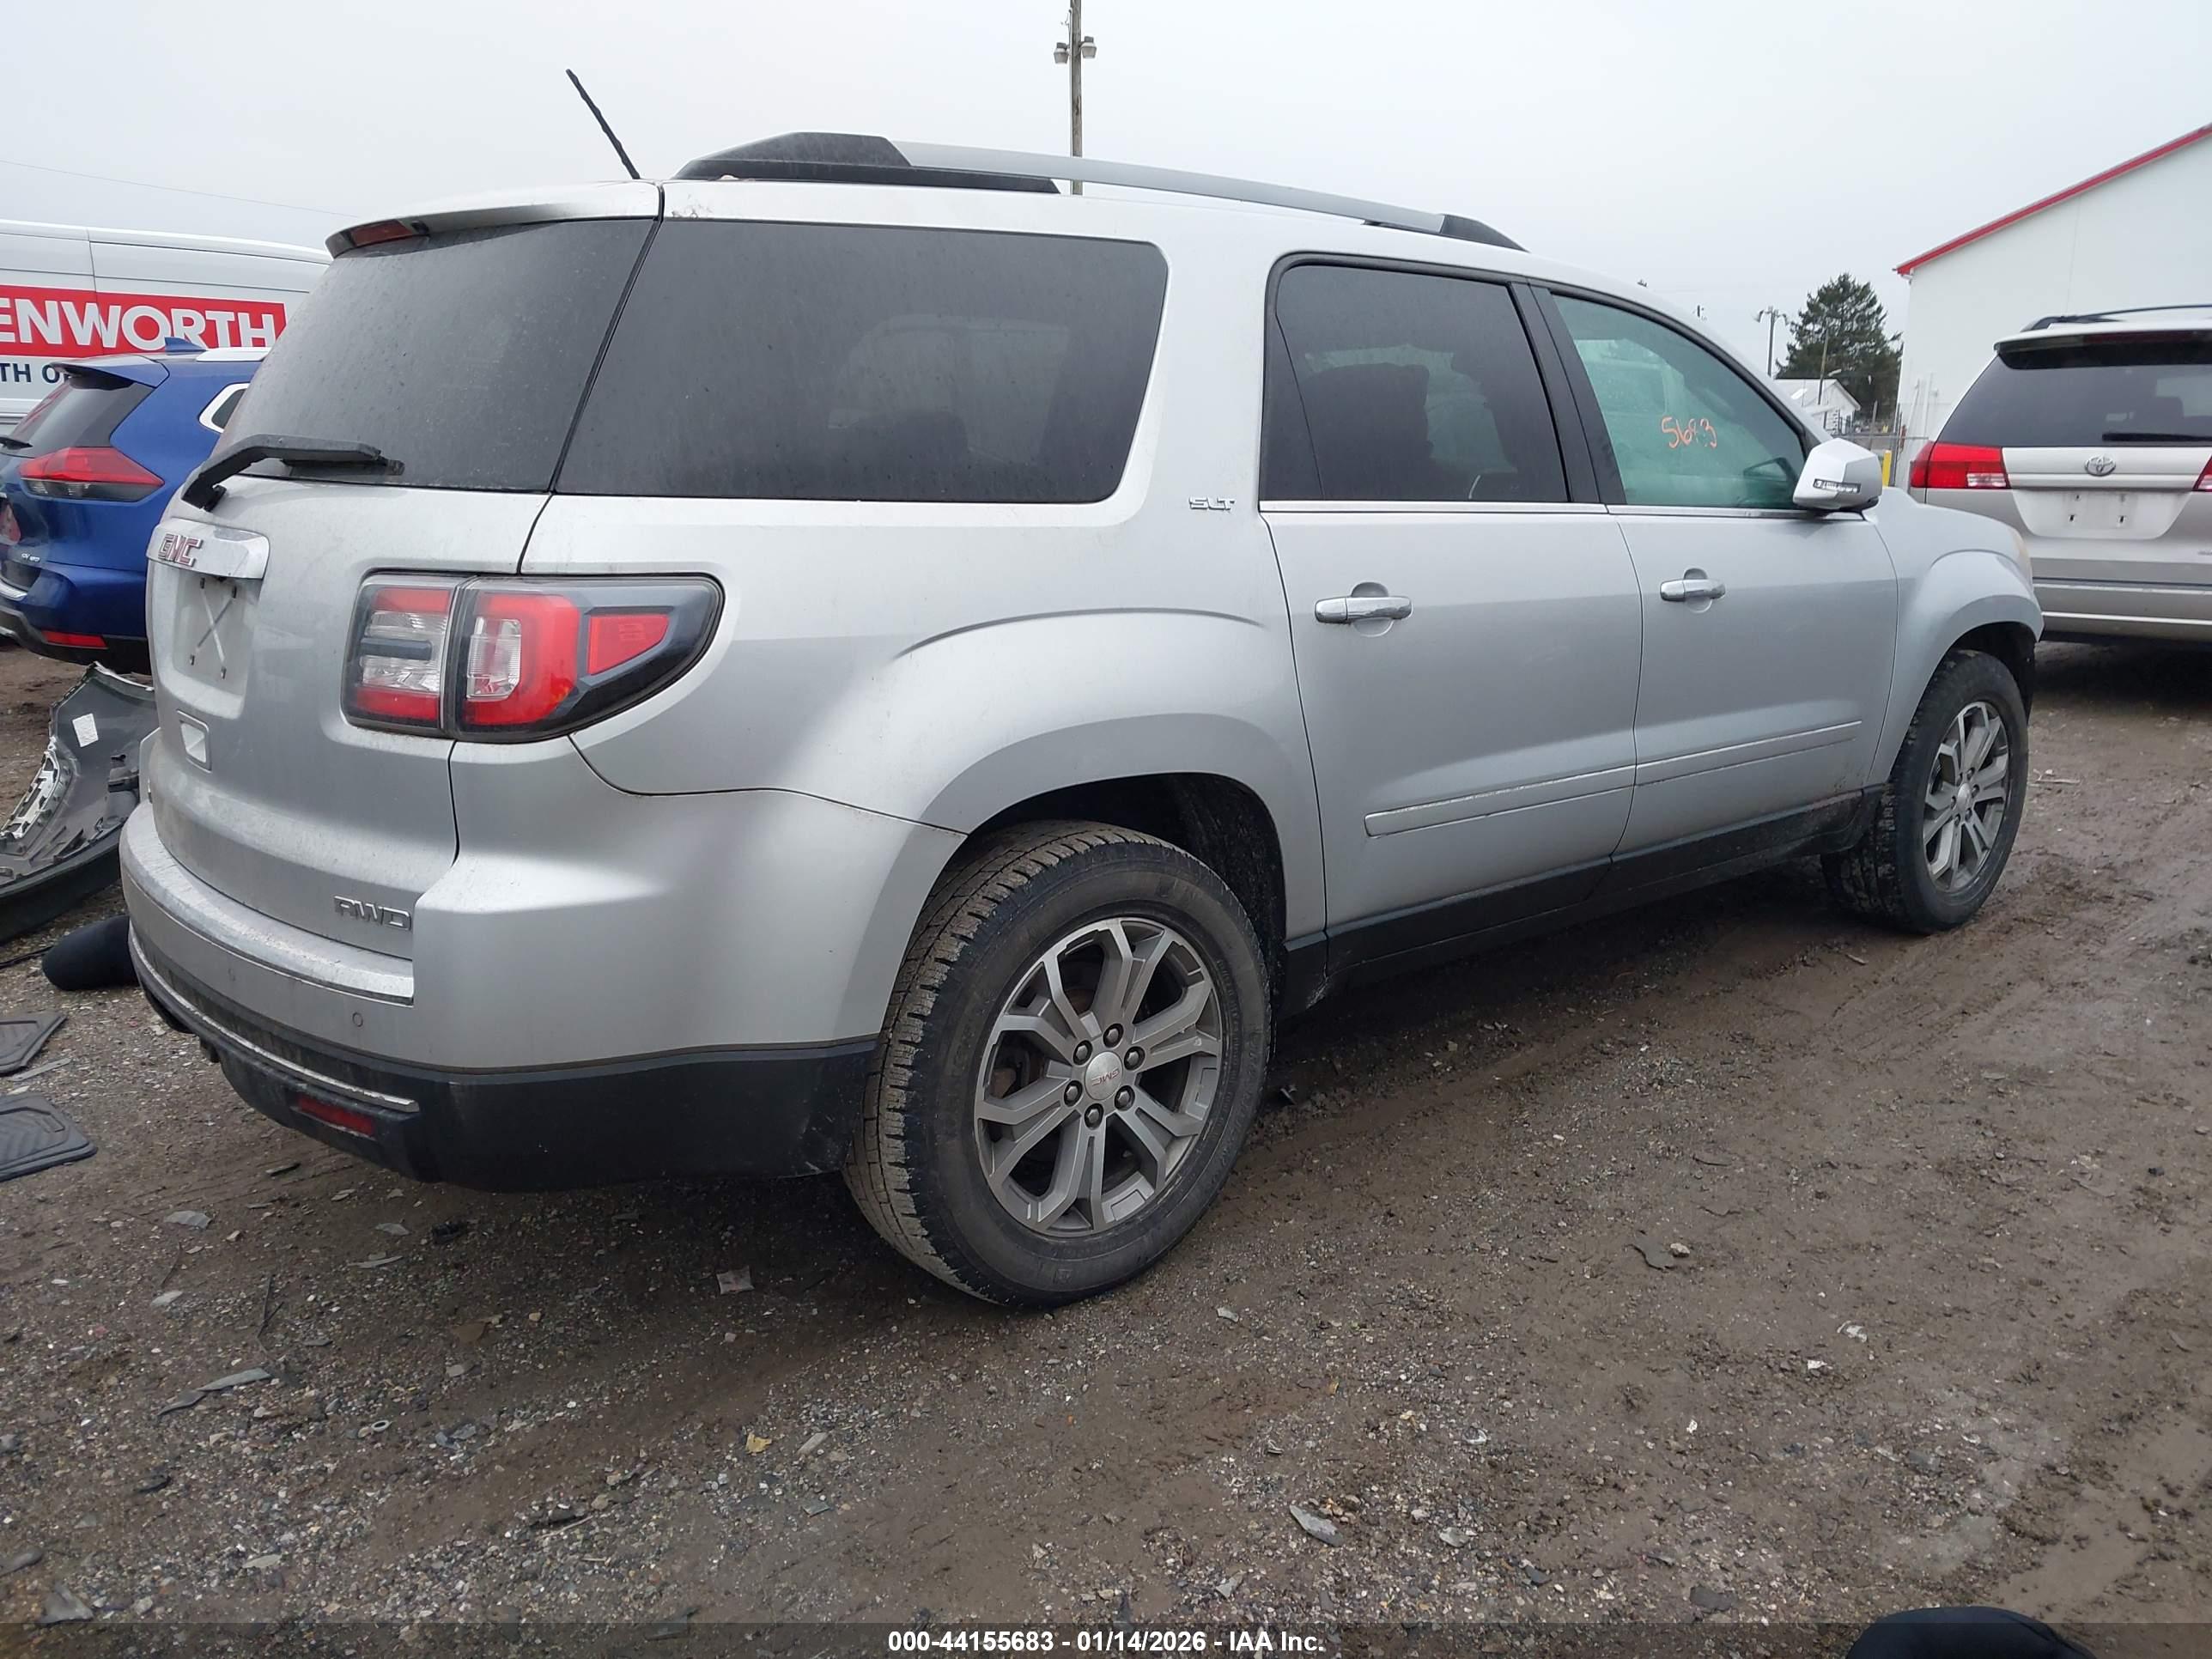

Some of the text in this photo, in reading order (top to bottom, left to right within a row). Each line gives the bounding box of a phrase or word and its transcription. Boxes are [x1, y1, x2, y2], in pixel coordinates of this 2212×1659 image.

[1188, 496, 1236, 511] SLT
[158, 532, 203, 568] GMC
[333, 895, 412, 931] AWD
[1091, 1066, 1120, 1087] GMC
